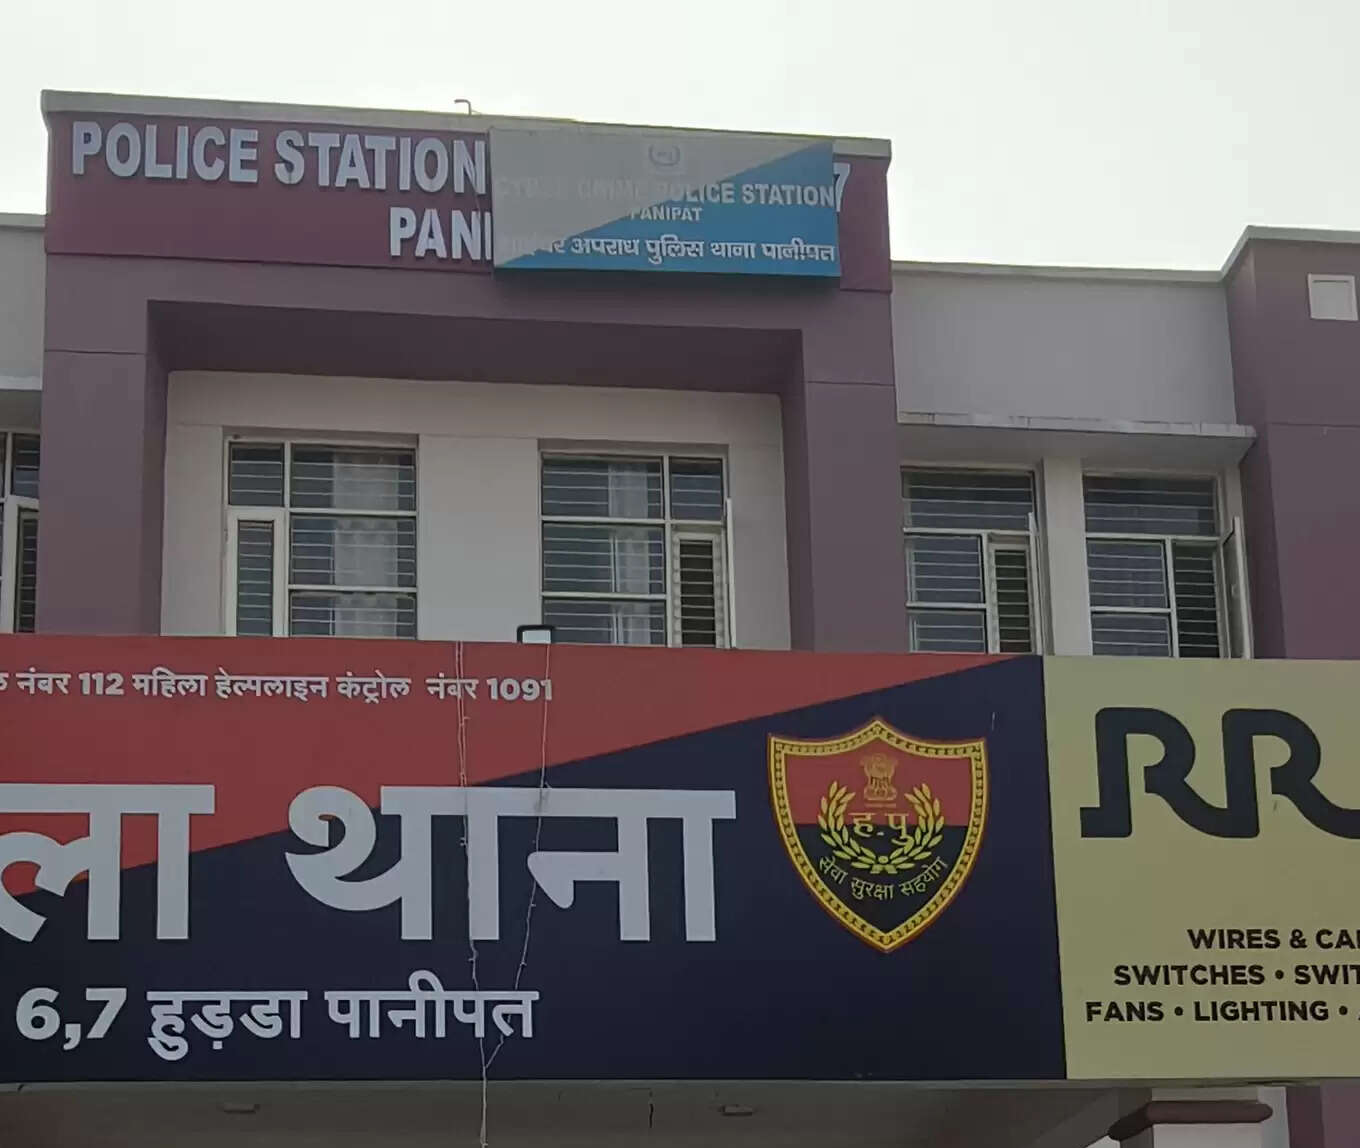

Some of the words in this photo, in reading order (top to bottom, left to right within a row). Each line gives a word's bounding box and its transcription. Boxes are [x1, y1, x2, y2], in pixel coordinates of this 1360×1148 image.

[72, 120, 258, 183] POLICE
[274, 129, 487, 195] STATION
[742, 183, 834, 207] STATION
[390, 206, 491, 261] PANI
[571, 236, 640, 255] अपराध
[644, 233, 705, 265] पुलिस
[711, 240, 756, 260] थाना
[761, 236, 836, 262] पानीपत
[15, 667, 71, 696] नंबर
[78, 672, 125, 696] 112
[132, 667, 208, 699] महिला
[214, 667, 329, 701] हेल्पलाइन
[336, 669, 412, 703] कंट्रोल
[426, 672, 479, 700] नंबर
[486, 677, 553, 701] 1091
[285, 785, 736, 943] थाना
[819, 855, 849, 885] सेवा
[851, 877, 894, 901] सुरक्षा
[899, 856, 949, 896] सहयोग
[1187, 928, 1281, 950] WIRES
[1289, 928, 1308, 949] &
[1113, 963, 1265, 986] SWITCHES
[15, 986, 128, 1051] 6,7
[324, 970, 540, 1039] पानीपत
[1085, 1000, 1165, 1022] FANS
[1193, 1000, 1330, 1022] LIGHTING
